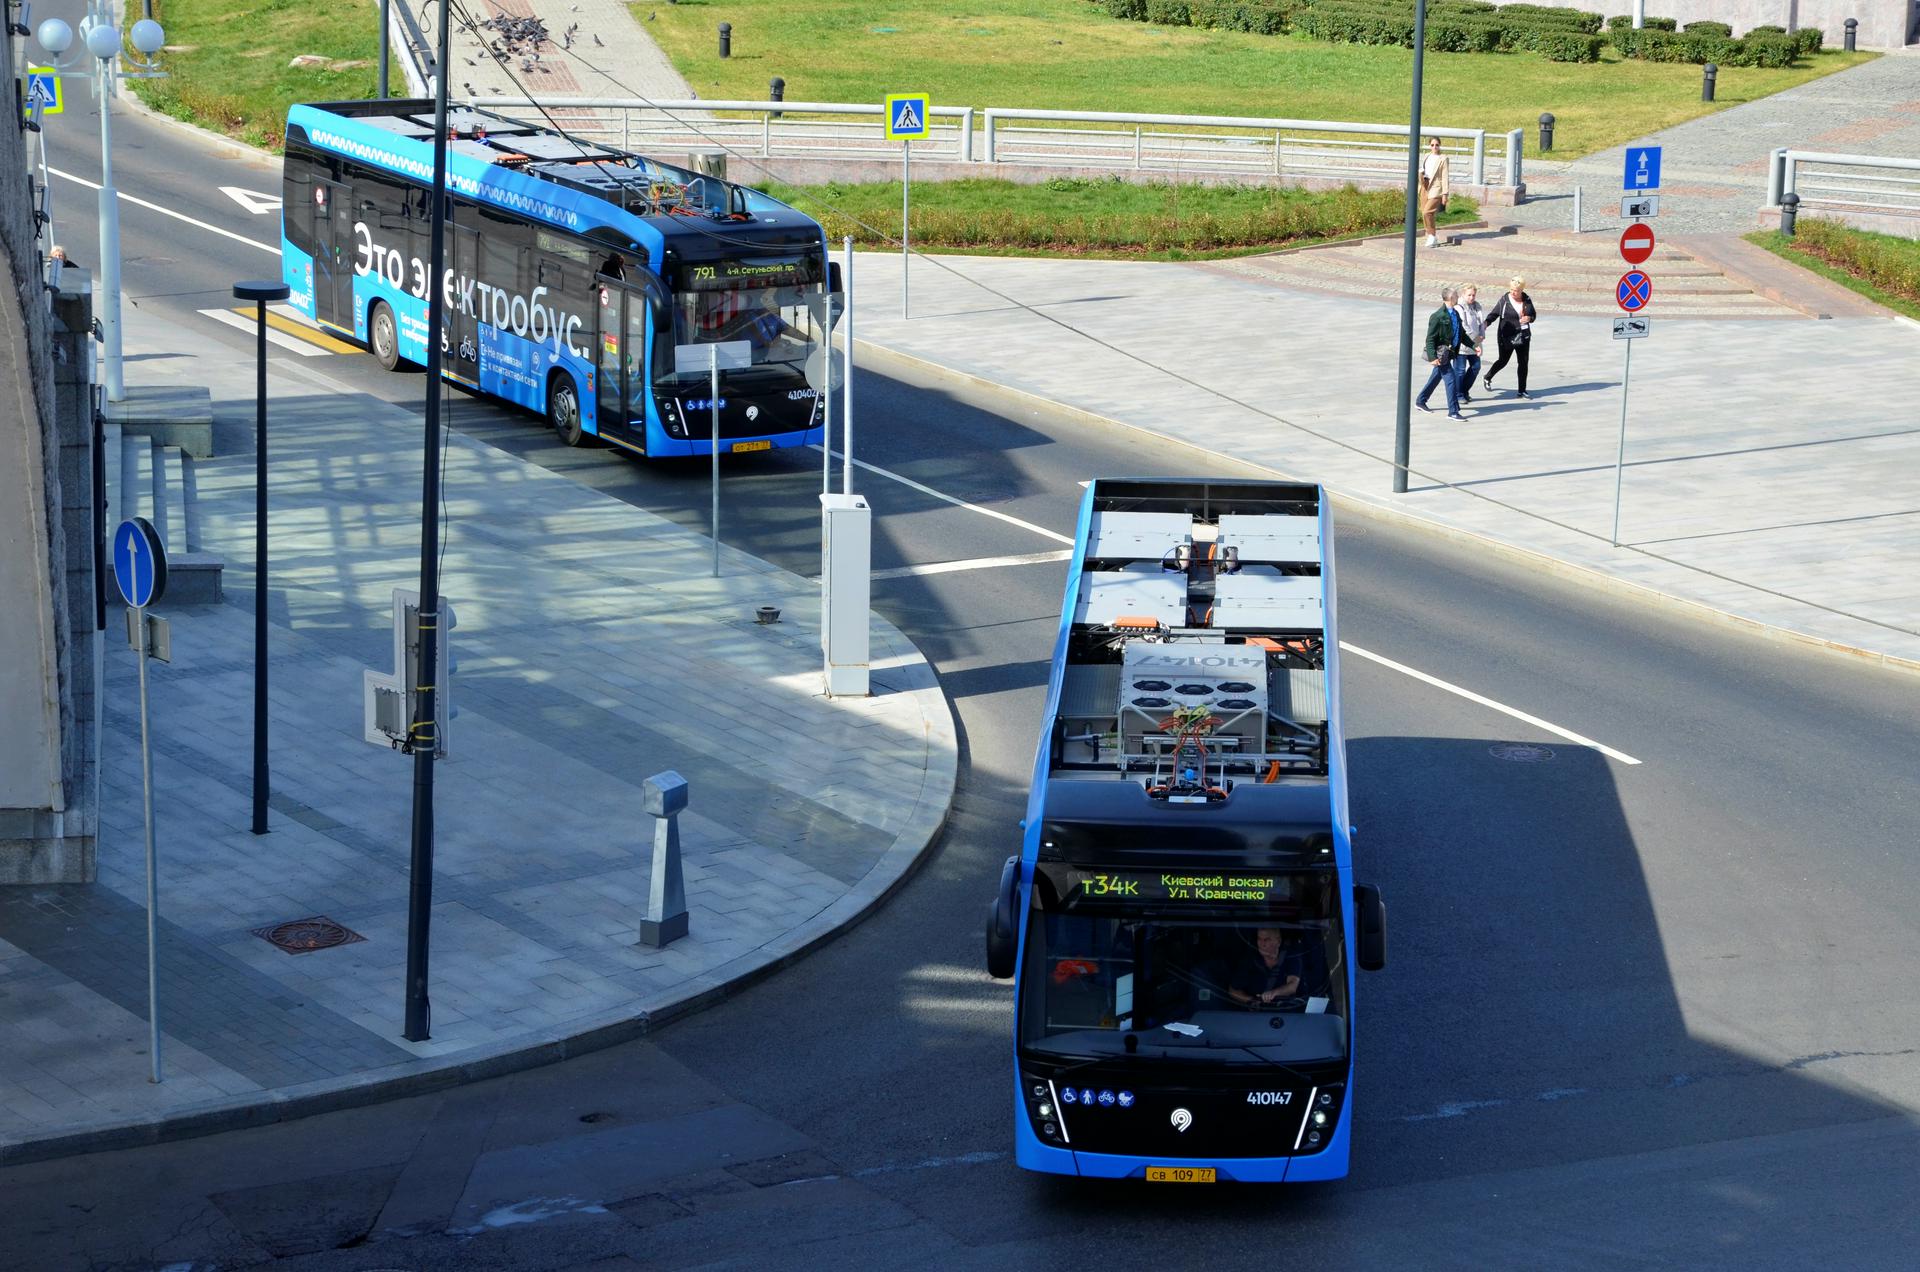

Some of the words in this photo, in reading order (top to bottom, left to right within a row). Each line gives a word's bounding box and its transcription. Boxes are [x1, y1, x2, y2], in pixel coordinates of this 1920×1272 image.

[354, 221, 404, 290] Это
[693, 266, 717, 280] 791
[741, 264, 783, 275] Сетуньский
[787, 388, 816, 400] 410402
[1161, 874, 1223, 887] Киевский
[1228, 877, 1274, 888] вокзал
[1169, 887, 1190, 899] Ул.
[1195, 888, 1265, 900] Кравченко
[1246, 1091, 1292, 1105] 410147
[1172, 1169, 1193, 1180] 109
[1200, 1169, 1212, 1178] 77
